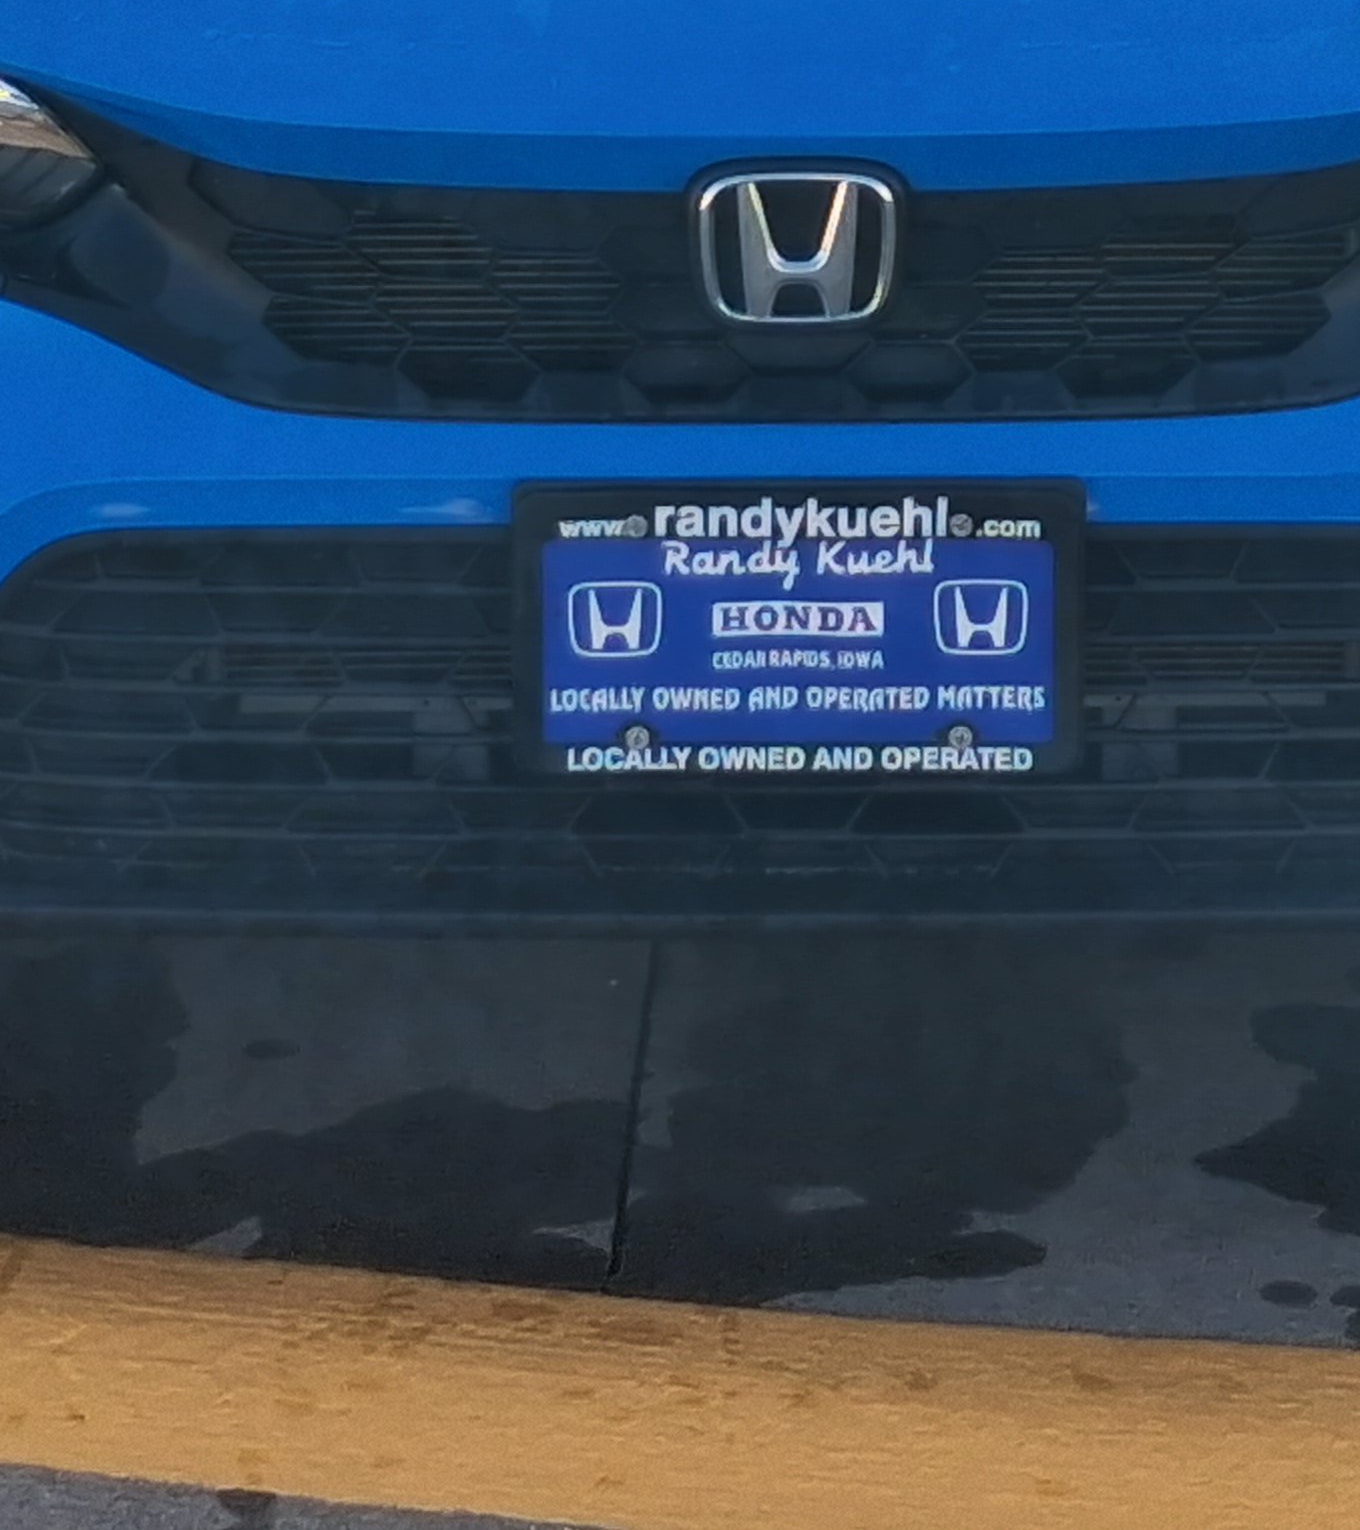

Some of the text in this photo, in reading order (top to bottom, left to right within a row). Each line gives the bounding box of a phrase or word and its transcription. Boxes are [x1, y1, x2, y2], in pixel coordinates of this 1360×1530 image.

[654, 496, 949, 548] randykuehl
[976, 519, 1041, 538] .com
[661, 538, 934, 591] Randy Kuehl
[721, 605, 877, 631] HONDA
[550, 685, 1046, 713] LOCALLY OWNED AND OPERATED MATTERS
[567, 746, 1034, 772] LOCALLY OWNED AND OPERATED
